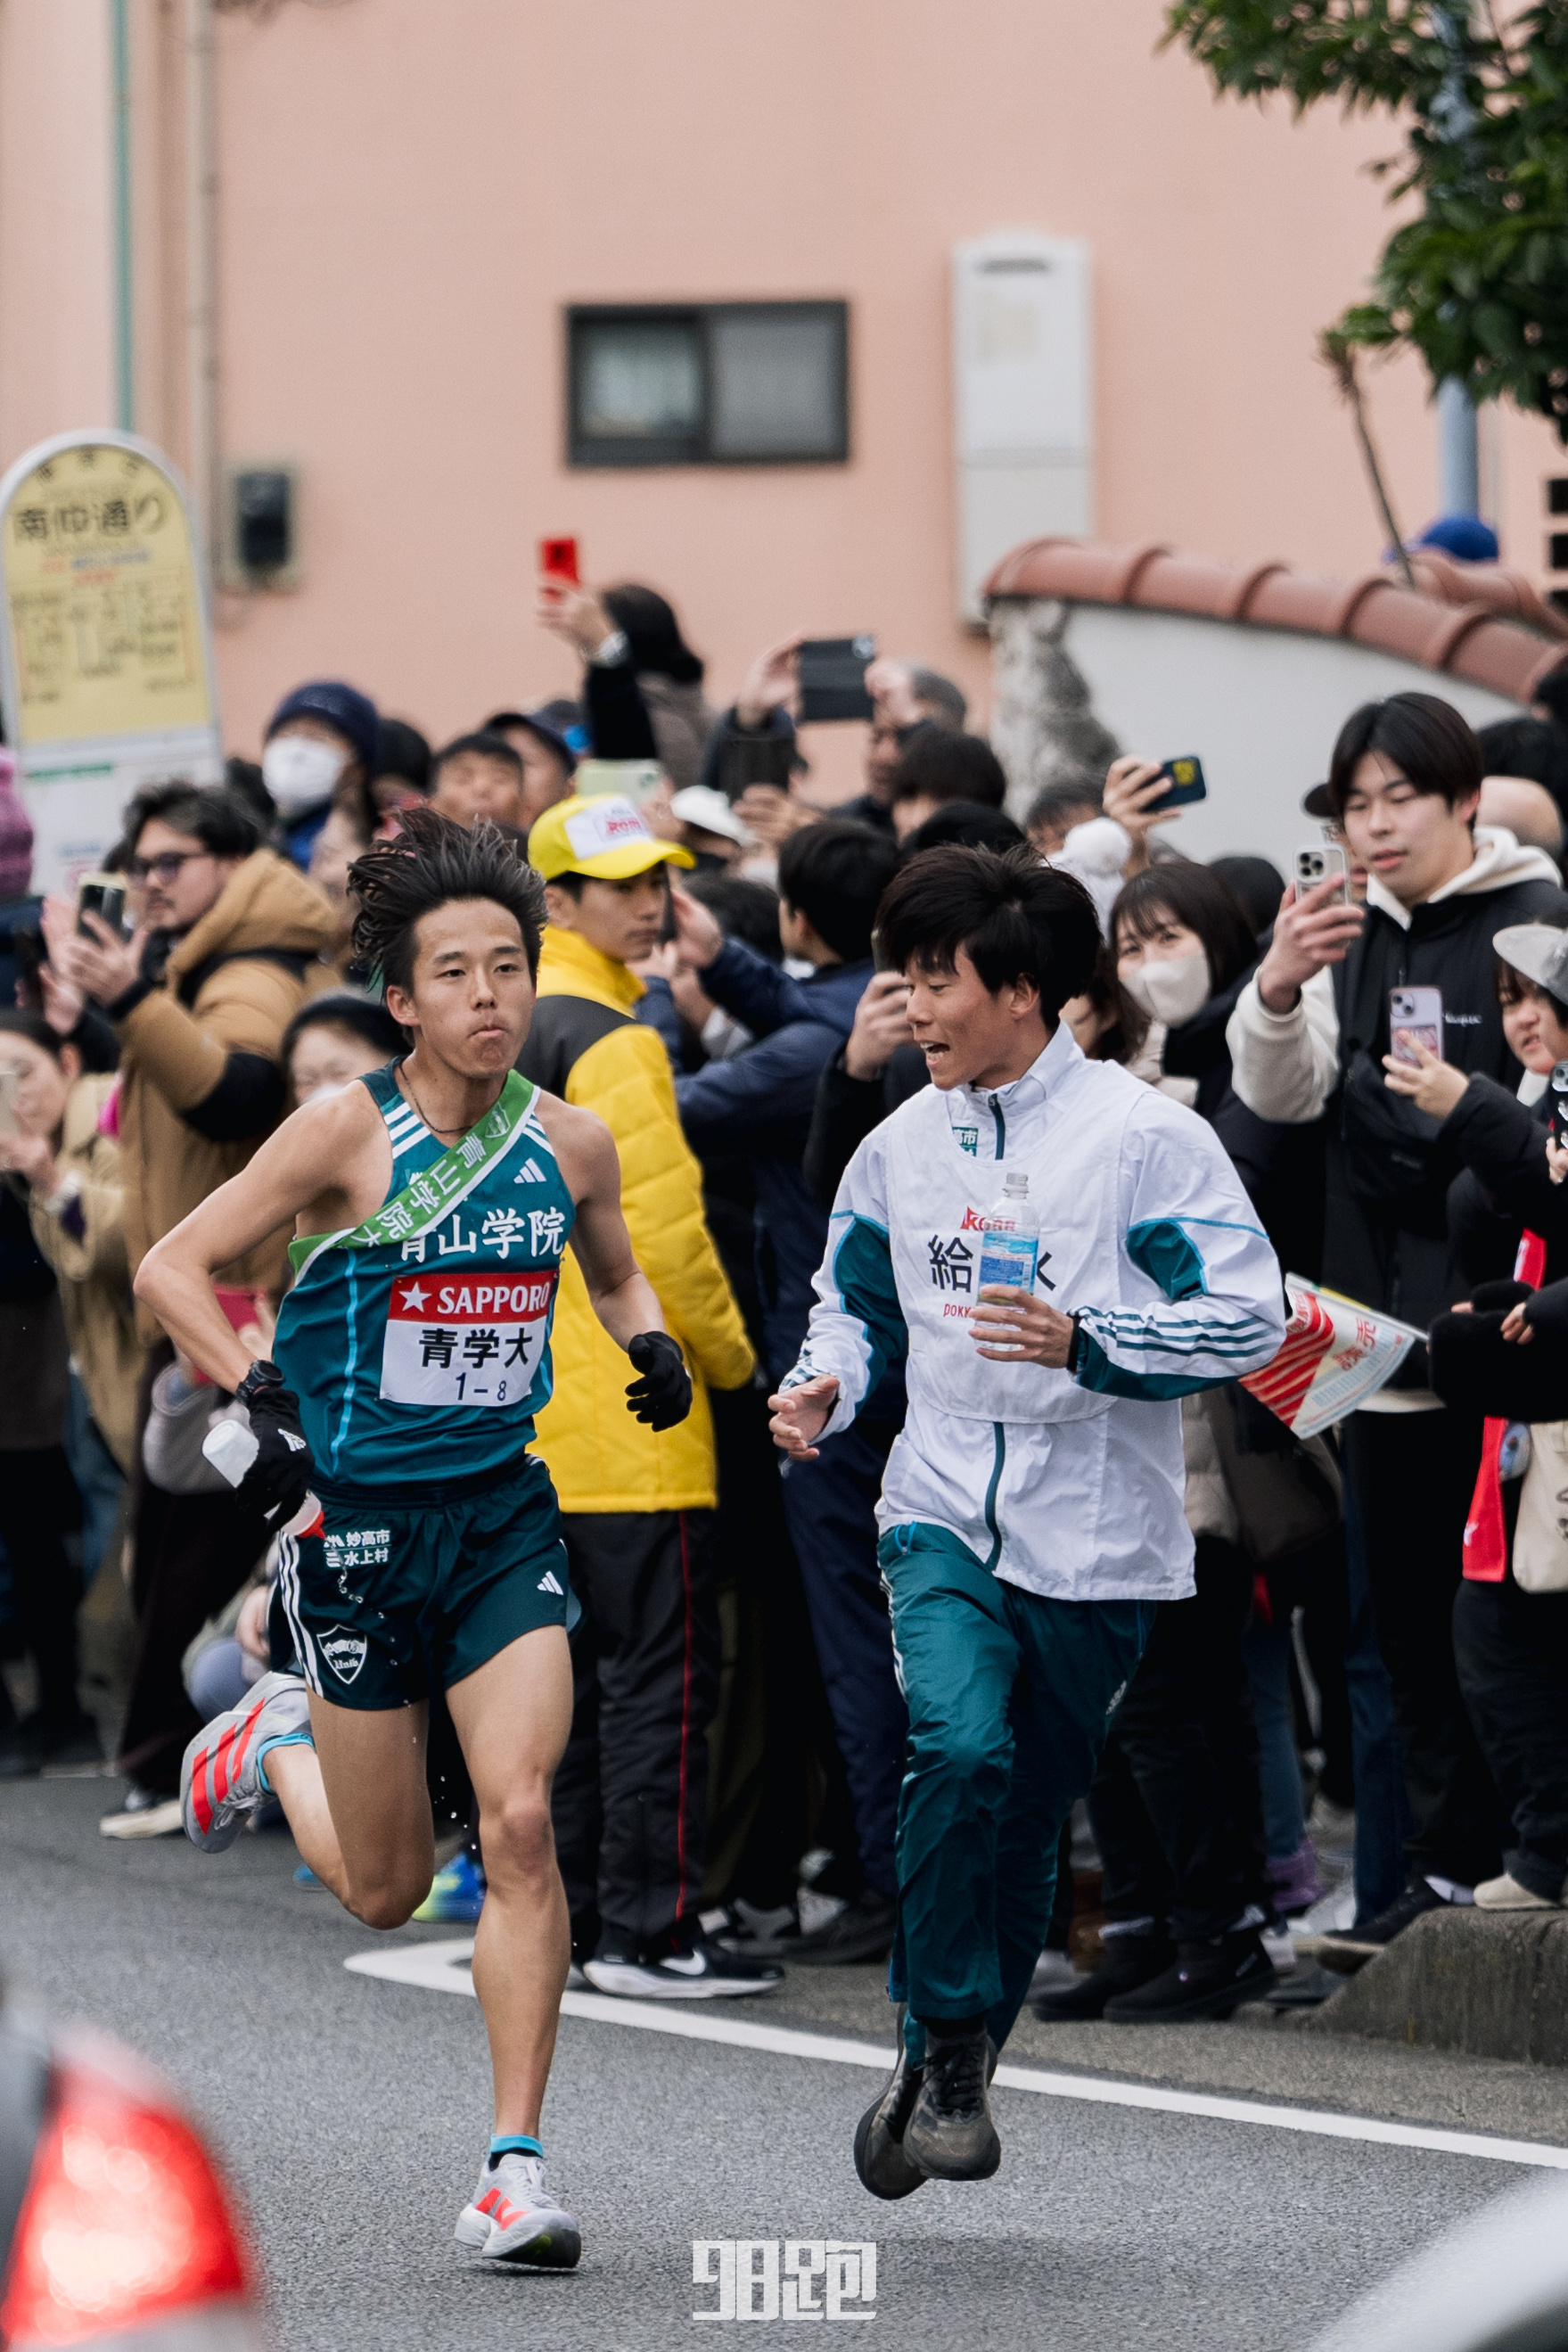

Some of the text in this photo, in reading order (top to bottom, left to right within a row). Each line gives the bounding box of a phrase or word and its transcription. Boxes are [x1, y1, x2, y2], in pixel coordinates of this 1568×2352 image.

[340, 1133, 486, 1248] 青山学院大
[437, 1282, 550, 1314] SAPPORO
[419, 1328, 533, 1369] 青学大
[346, 1530, 390, 1547] 妙高市
[344, 1548, 389, 1567] 水上村
